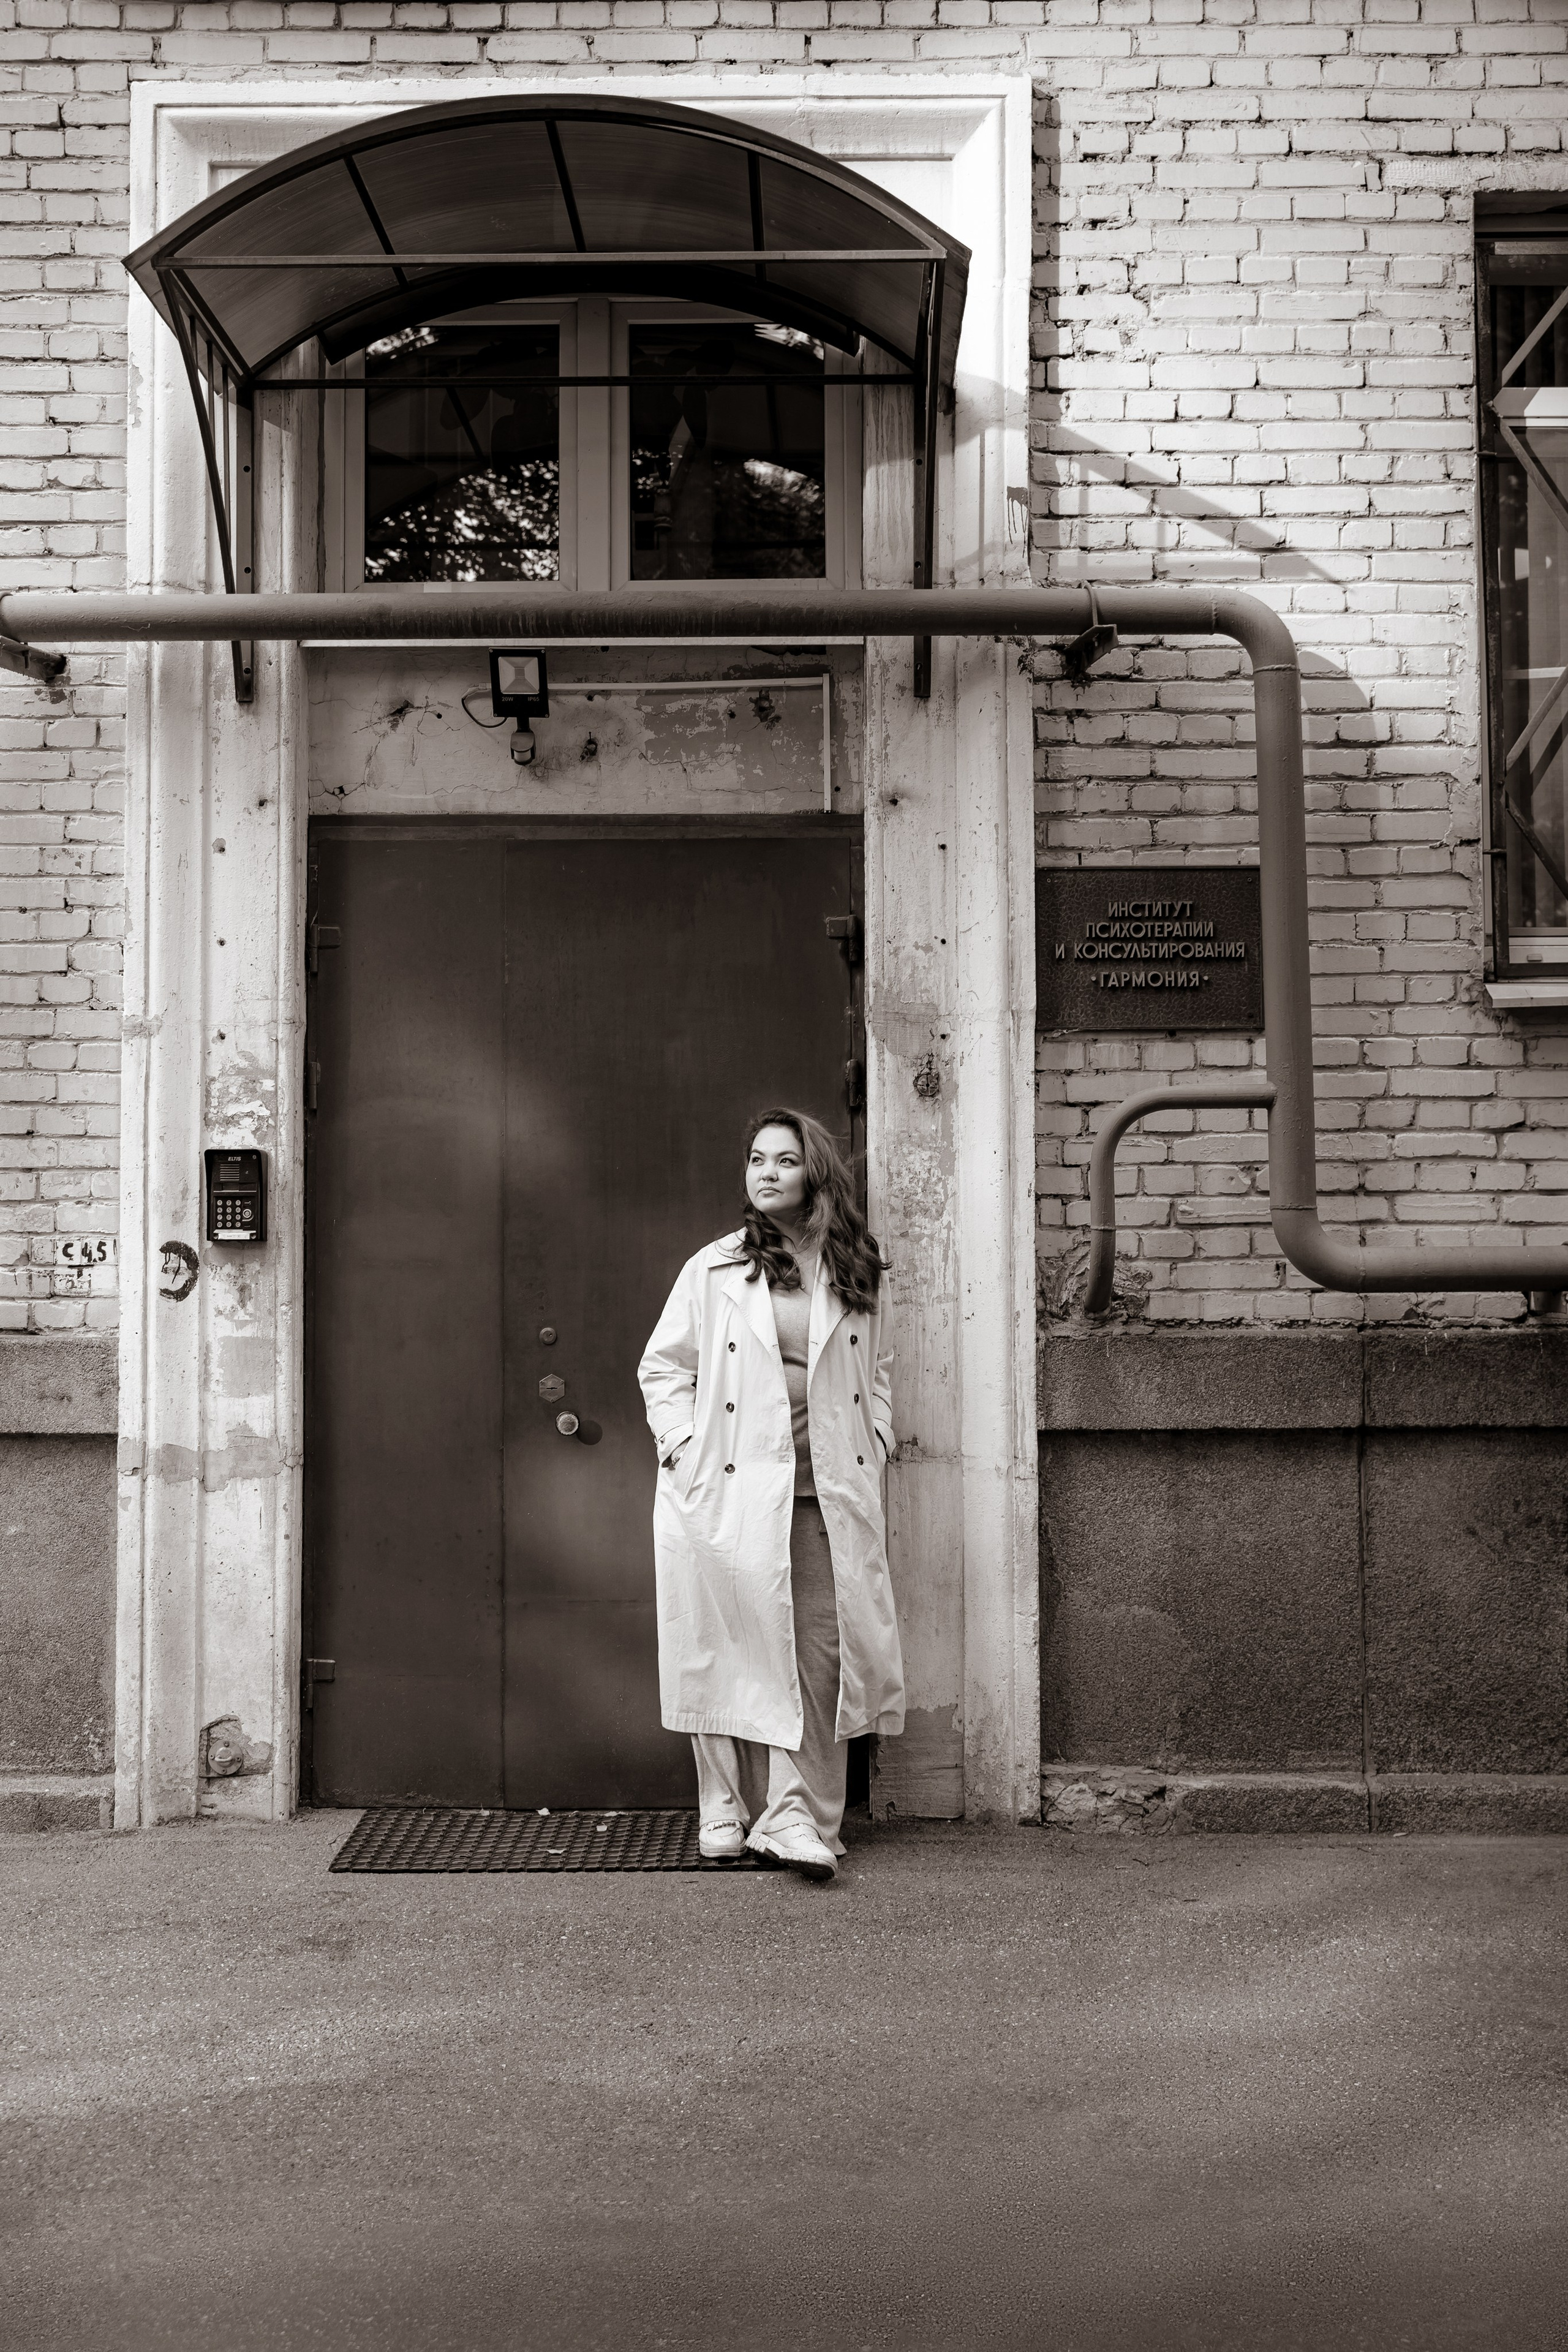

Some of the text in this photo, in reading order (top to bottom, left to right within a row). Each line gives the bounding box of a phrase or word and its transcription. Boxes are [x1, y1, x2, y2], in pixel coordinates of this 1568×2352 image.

[1107, 901, 1193, 918] ИНСТИТУТ
[1085, 921, 1214, 938] ПСИХОТЕРАПИИ
[1055, 941, 1246, 959] И КОНСУЛЬТИРОВАНИЯ
